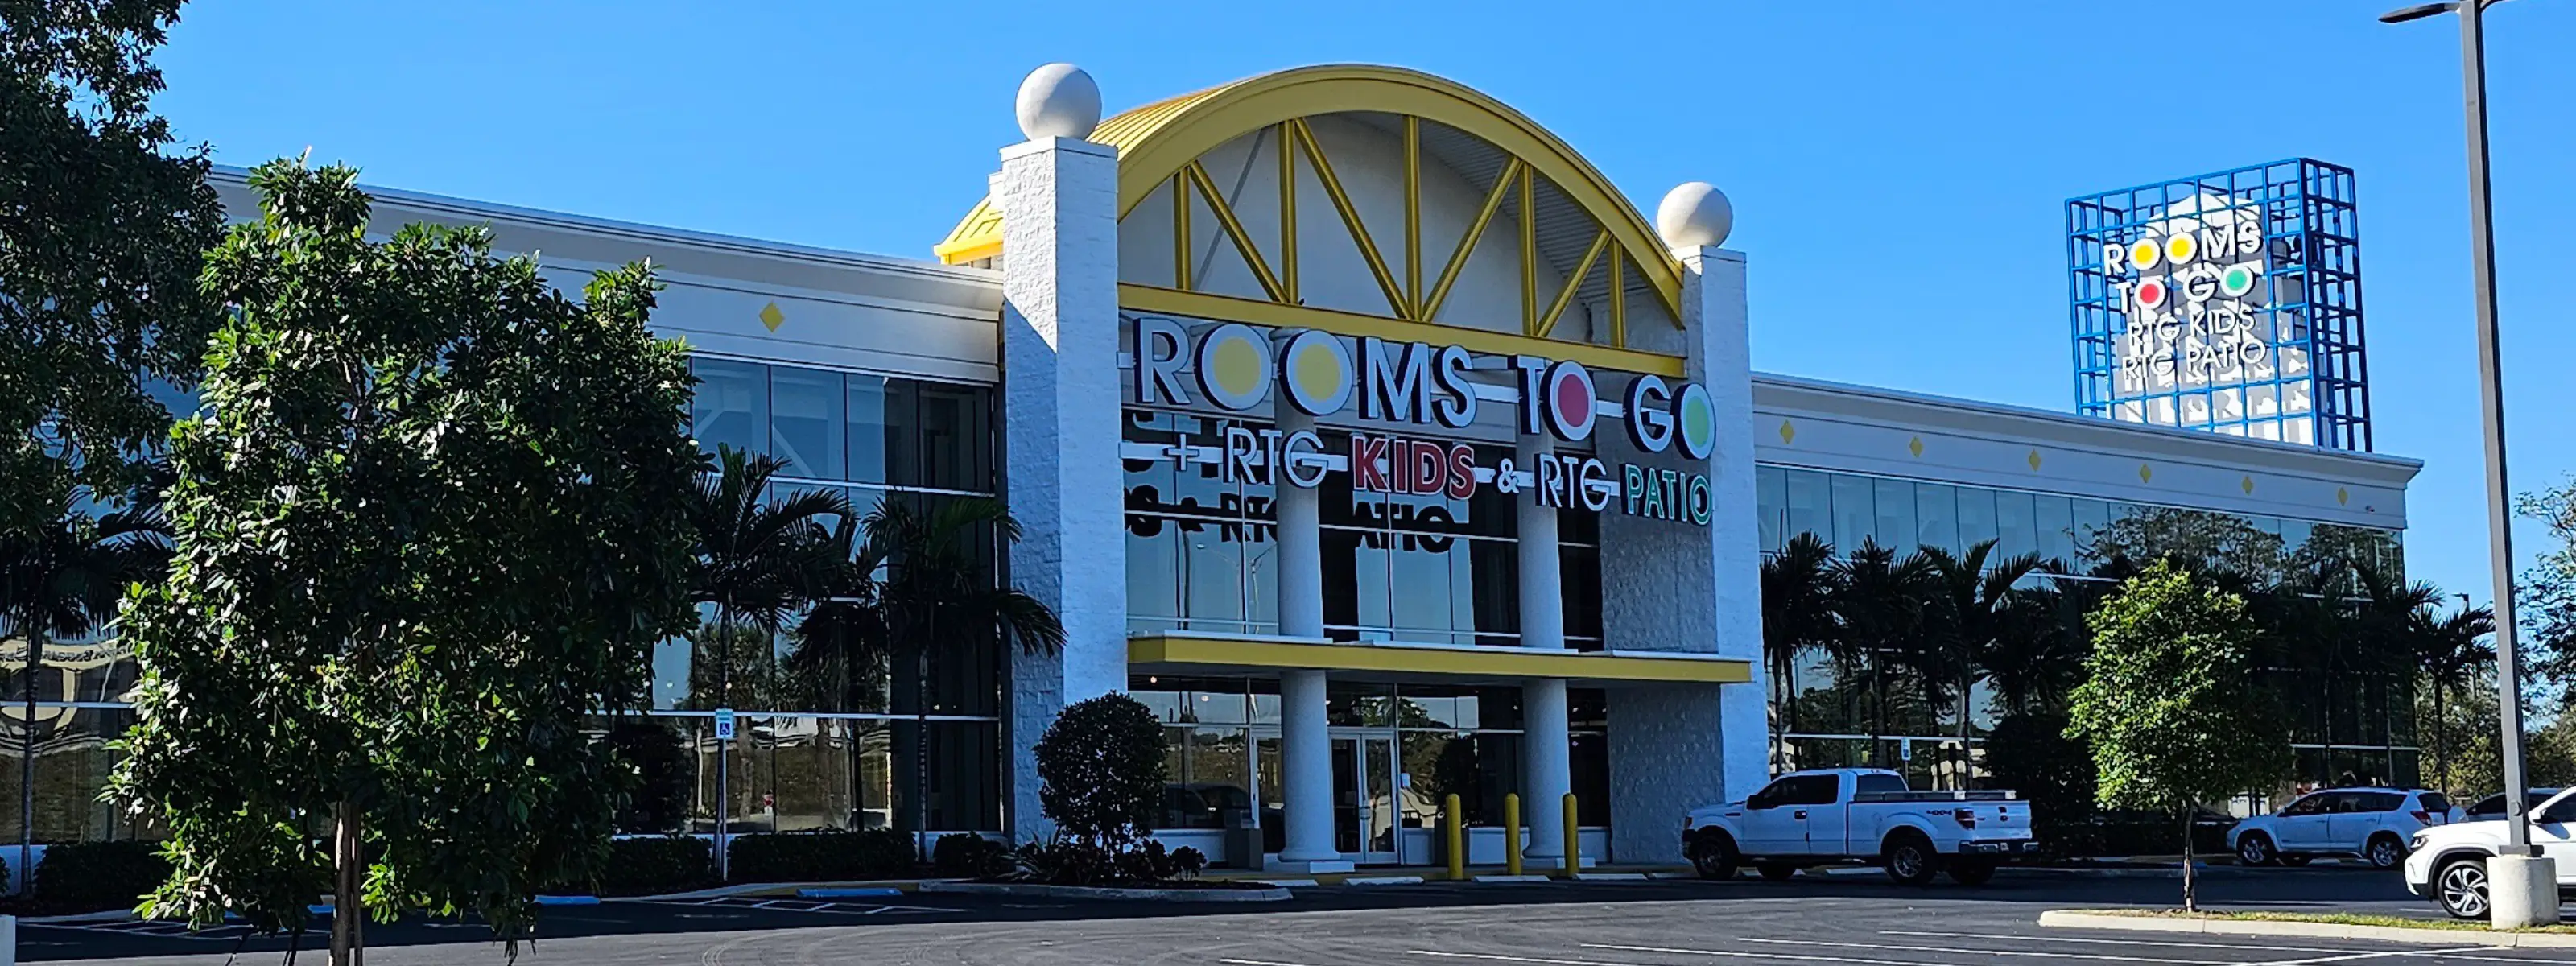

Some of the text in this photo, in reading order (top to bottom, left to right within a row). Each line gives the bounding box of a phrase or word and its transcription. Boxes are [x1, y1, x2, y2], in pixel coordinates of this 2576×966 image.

[2103, 221, 2261, 276] ROOMS
[2116, 263, 2254, 315] TO GO
[2128, 303, 2255, 345] RTG KIDS
[2122, 338, 2266, 382] RTG PATIO
[1134, 317, 1717, 460] ROOMS TO GO
[1223, 427, 1329, 488] RTG
[1352, 435, 1477, 501] KIDS
[1496, 457, 1520, 494] &
[1534, 453, 1610, 512] RTG
[1620, 463, 1713, 526] PATIO
[1352, 501, 1455, 554] ATIO
